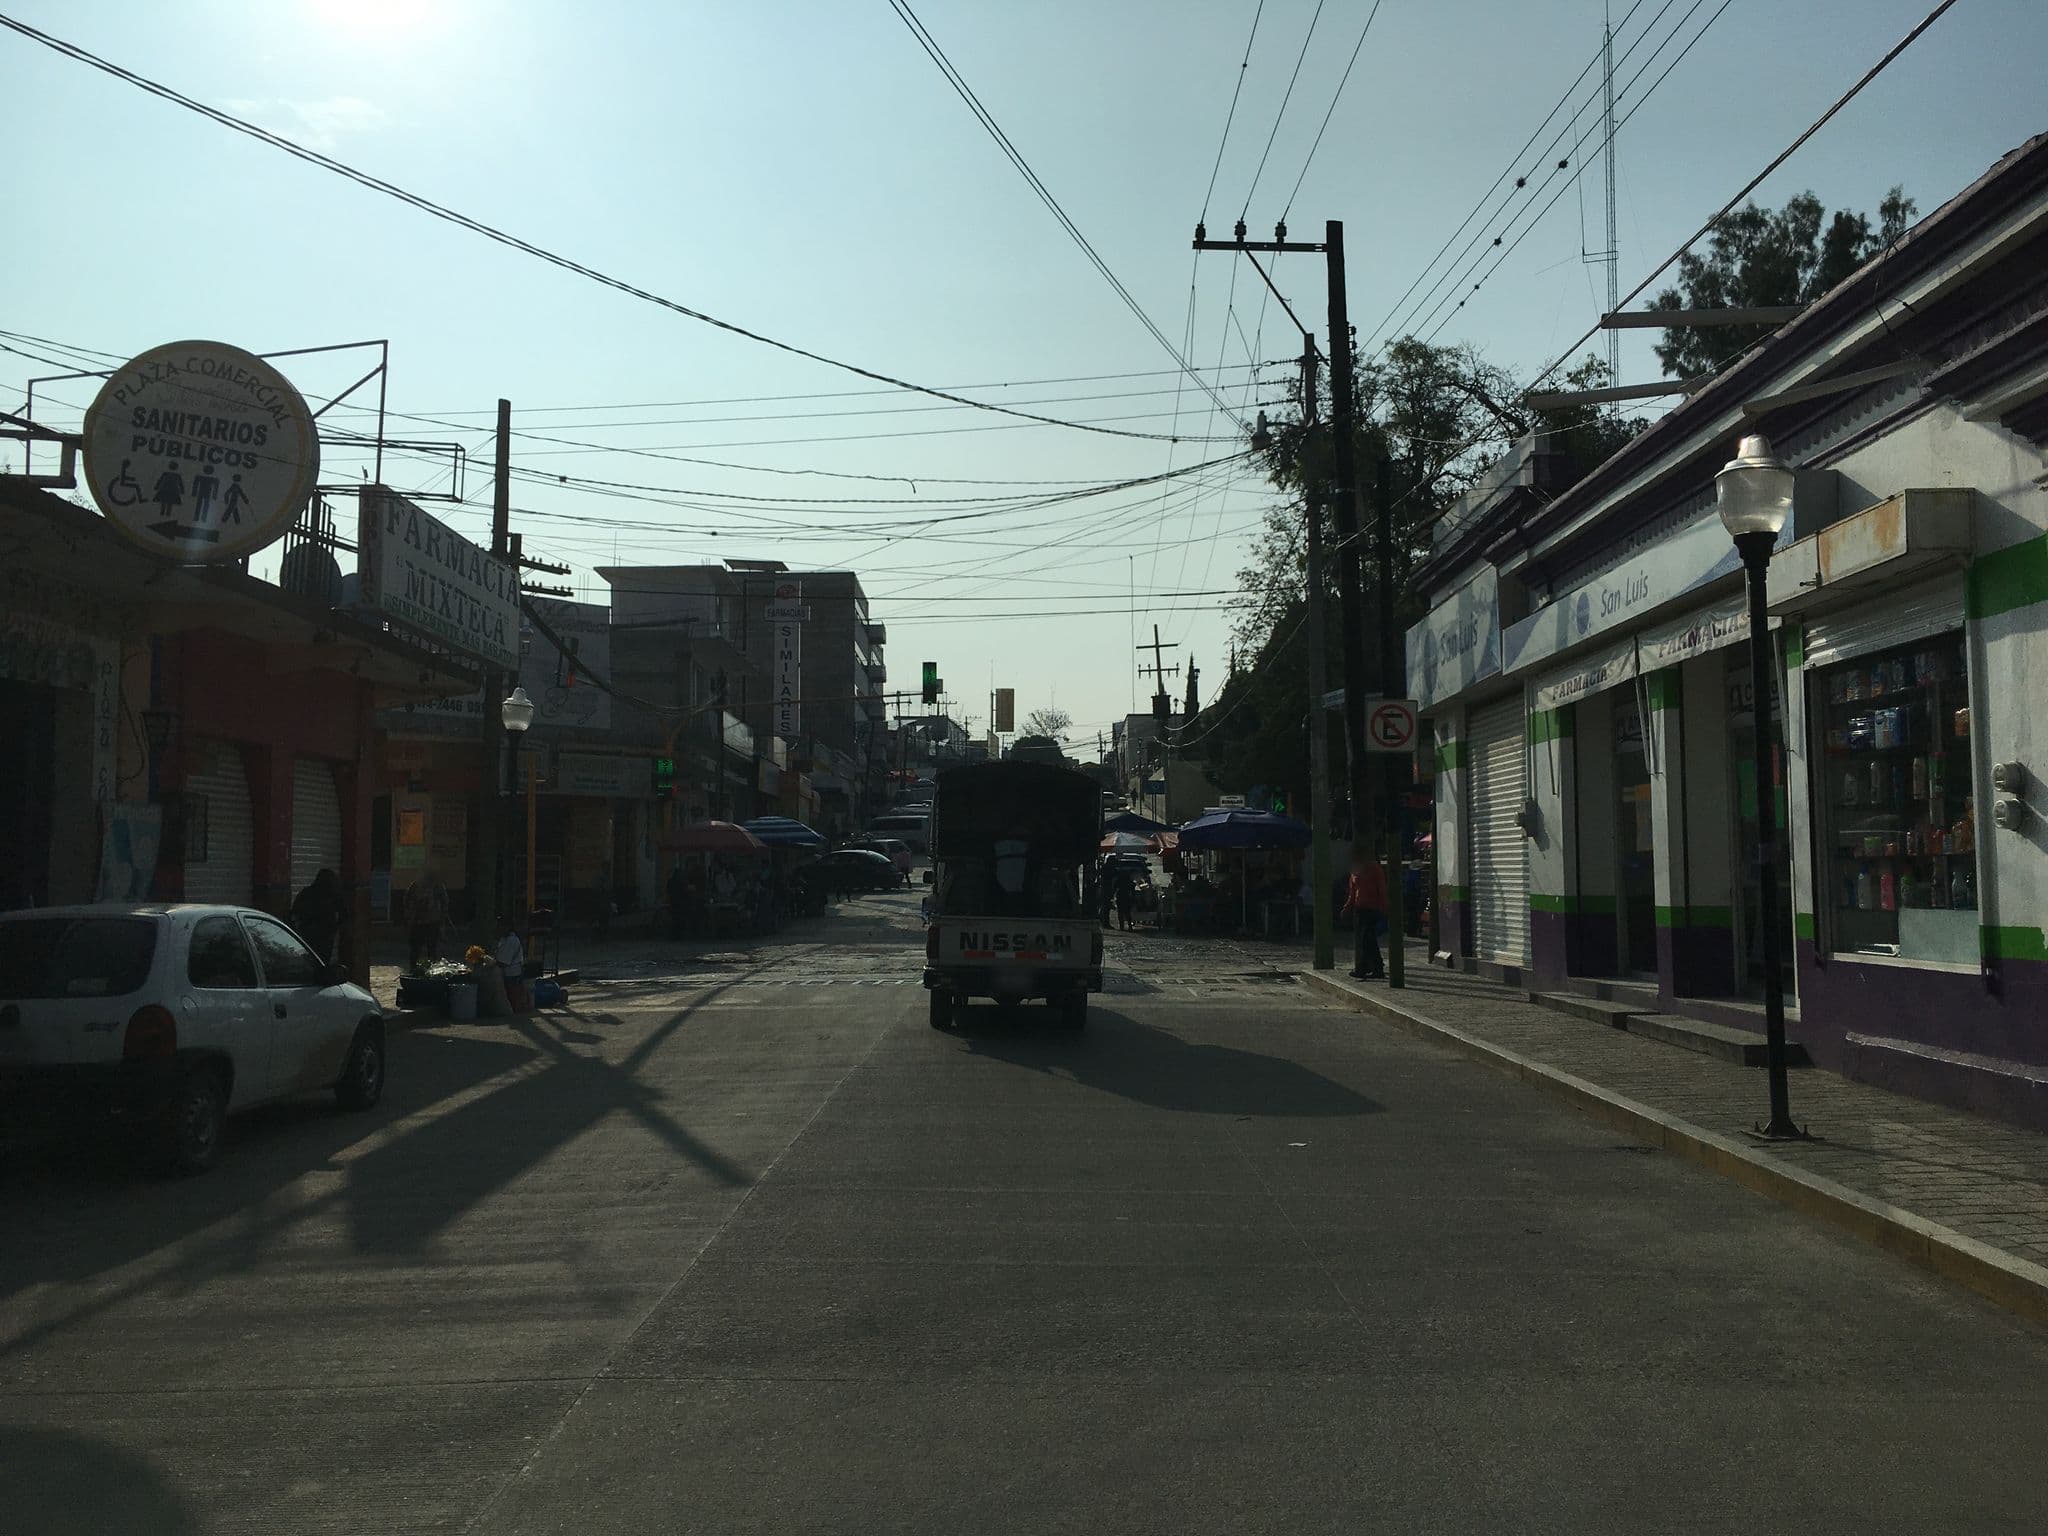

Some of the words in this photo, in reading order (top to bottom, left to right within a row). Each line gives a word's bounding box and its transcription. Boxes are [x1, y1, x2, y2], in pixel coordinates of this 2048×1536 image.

[113, 361, 180, 406] PLAZA
[186, 357, 294, 430] COMERCIAL
[131, 406, 268, 447] SANITARIOS
[385, 499, 520, 608] FARMACIA
[767, 607, 806, 618] FARMACIAS
[1600, 588, 1622, 618] San
[1625, 569, 1649, 607] Luis
[779, 626, 793, 732] SIMILARES
[959, 931, 1073, 953] NISSAN
